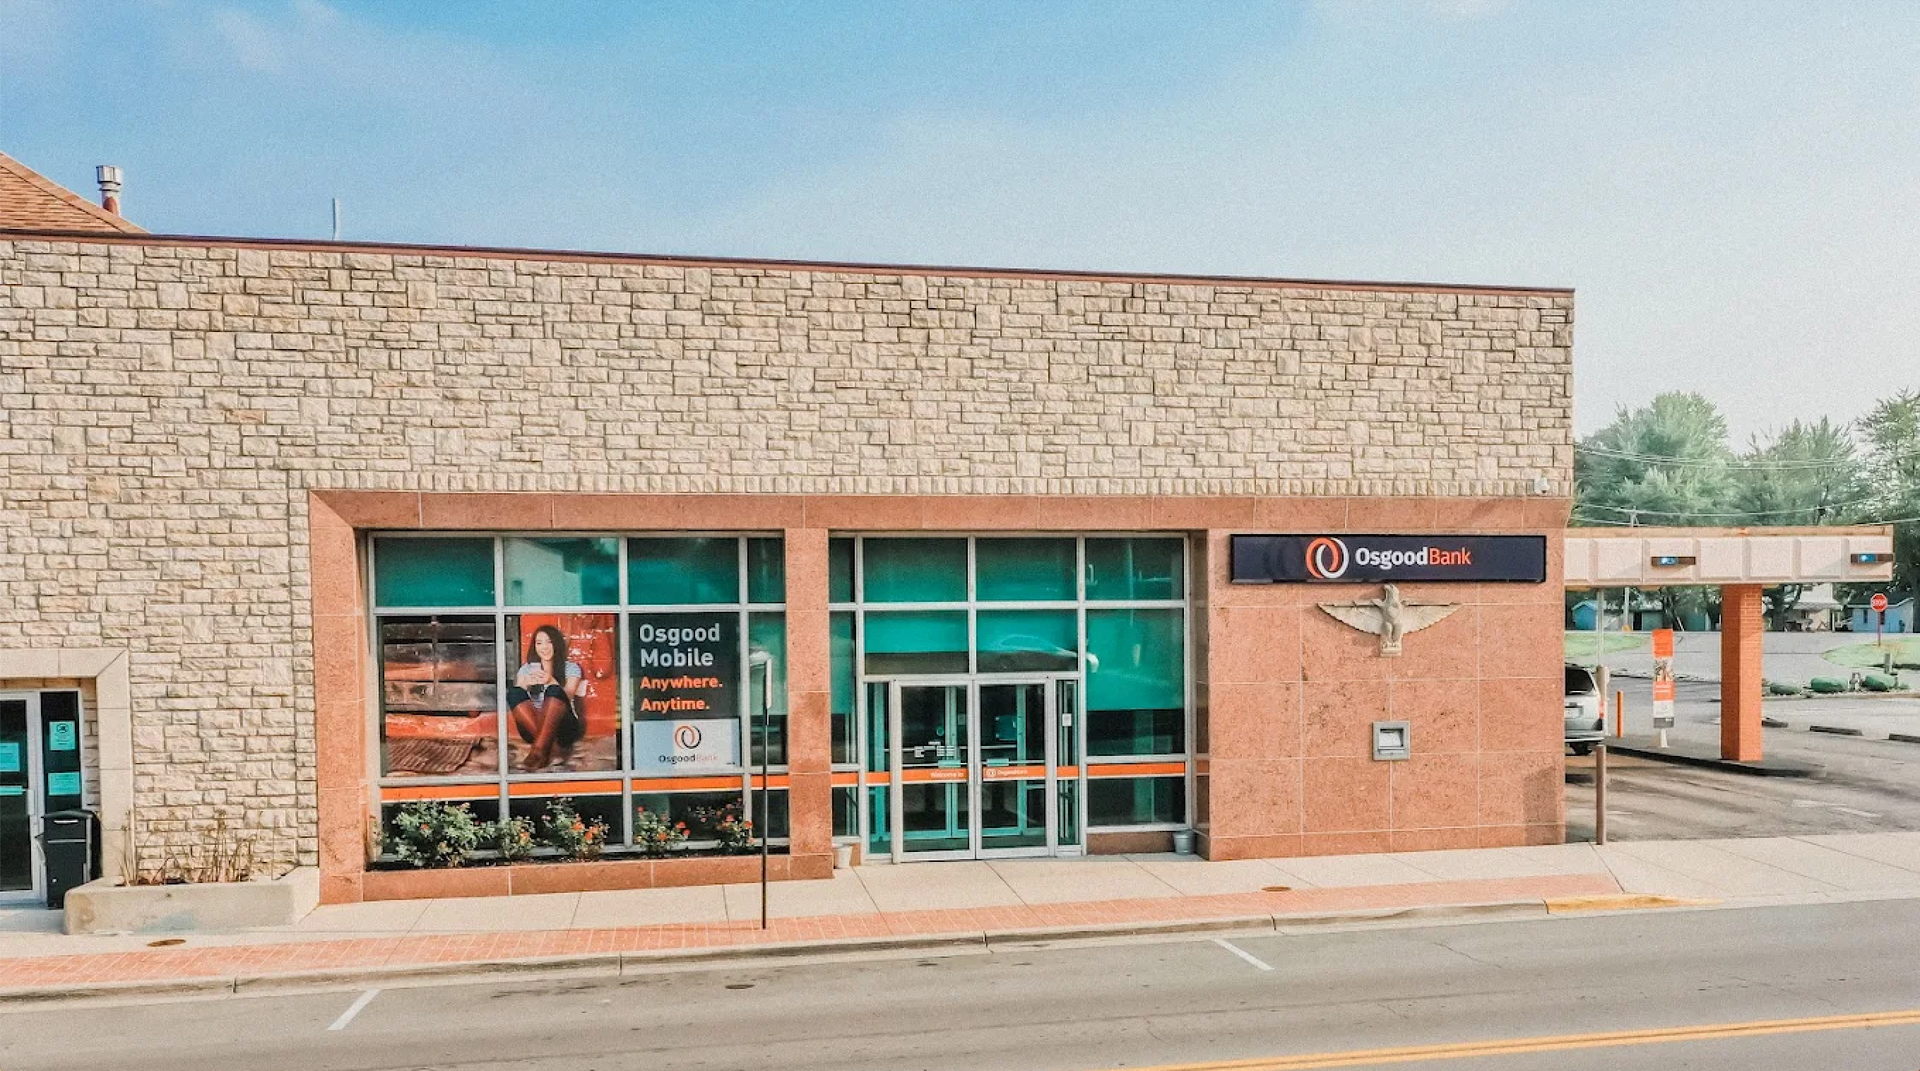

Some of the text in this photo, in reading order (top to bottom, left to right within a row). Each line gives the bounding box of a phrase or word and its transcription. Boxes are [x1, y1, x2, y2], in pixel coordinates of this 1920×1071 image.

[1355, 546, 1471, 570] OsgoodBank
[639, 622, 720, 646] Osgood
[640, 648, 714, 667] Mobile
[640, 675, 723, 692] Anywhere.
[641, 697, 710, 714] Anytime.
